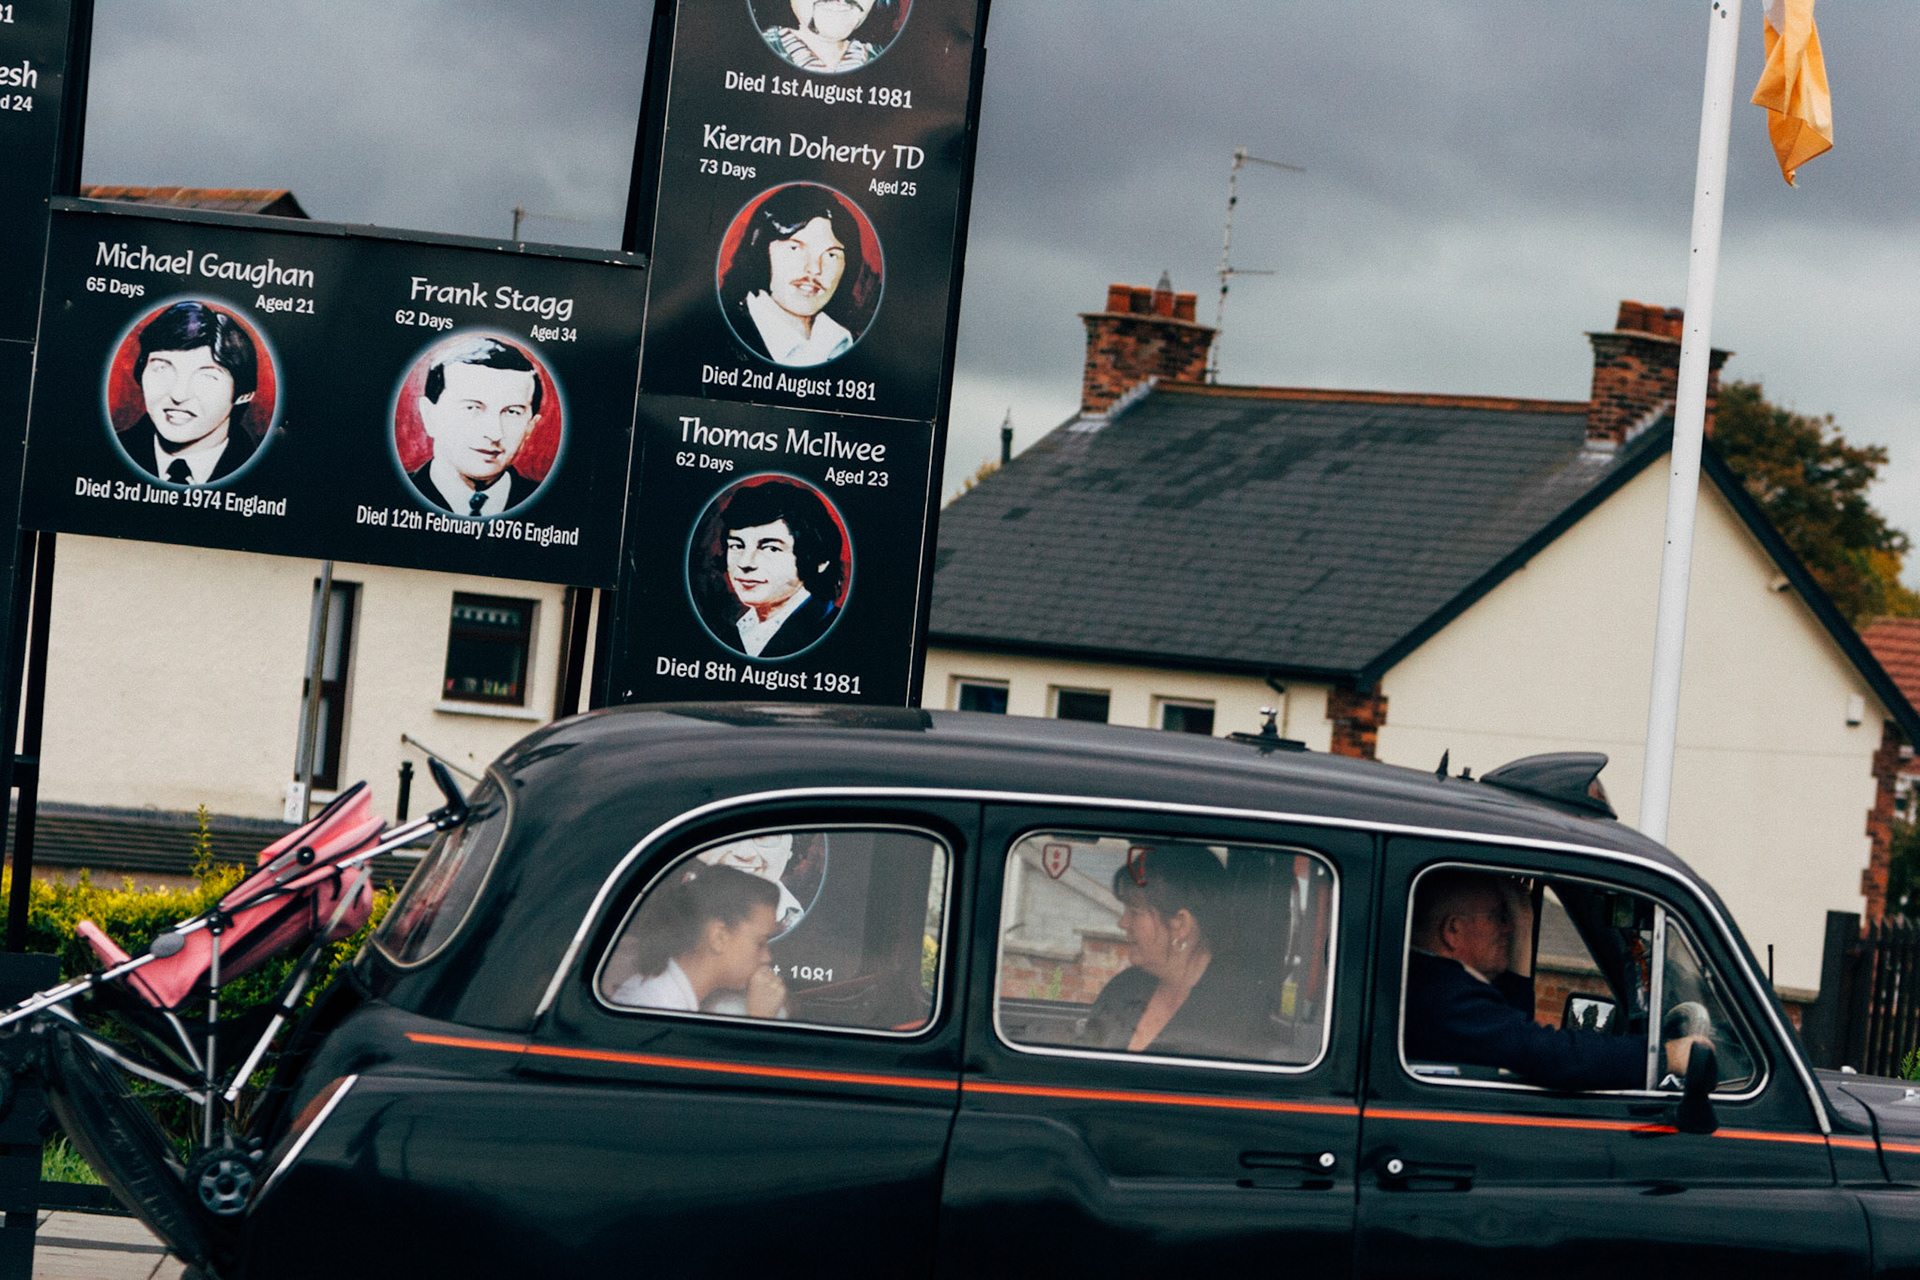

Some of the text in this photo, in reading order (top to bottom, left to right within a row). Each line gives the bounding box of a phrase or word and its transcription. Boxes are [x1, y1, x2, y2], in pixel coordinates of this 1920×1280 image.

[724, 70, 913, 109] Died 1st August 1981
[12, 94, 33, 112] 24
[703, 123, 925, 171] Kieran Doherty TD
[699, 158, 757, 181] 73 Days
[868, 177, 917, 197] Aged 25
[95, 241, 314, 289] Michael Gaughan
[86, 276, 145, 299] 65 Days
[410, 276, 574, 322] Frank Stagg
[254, 294, 315, 314] Aged 21
[395, 309, 454, 332] 62 Days
[529, 324, 577, 342] Aged 34
[701, 364, 876, 401] Died 2nd August 1981
[678, 416, 778, 452] Thomas
[676, 451, 734, 473] 62 Days
[824, 466, 889, 487] Aged 23
[75, 476, 287, 518] Died 3rd June 1974 England
[356, 505, 580, 547] Died 12th February 1976 England
[656, 656, 861, 695] Died 8th August 1981
[790, 964, 834, 983] 1981
